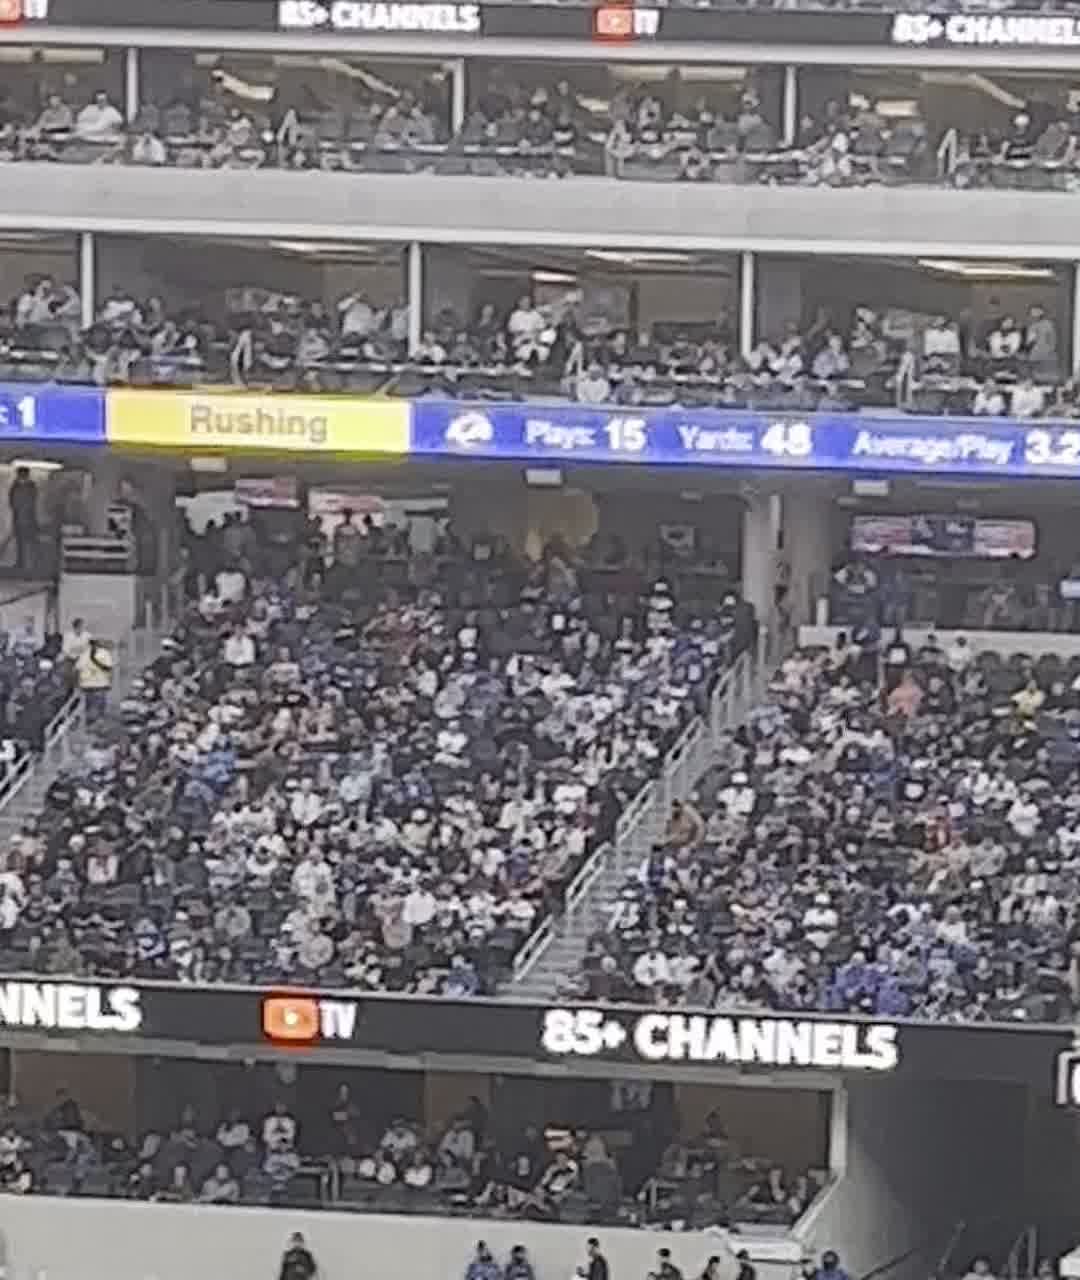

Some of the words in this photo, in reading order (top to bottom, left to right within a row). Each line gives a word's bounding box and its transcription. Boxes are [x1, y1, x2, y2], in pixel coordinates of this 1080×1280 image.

[331, 3, 481, 31] CHANNELS
[190, 405, 329, 444] Rushing
[604, 418, 648, 450] 15
[760, 421, 812, 457] 48
[541, 1007, 626, 1054] 85+
[633, 1015, 899, 1070] CHANNELS
